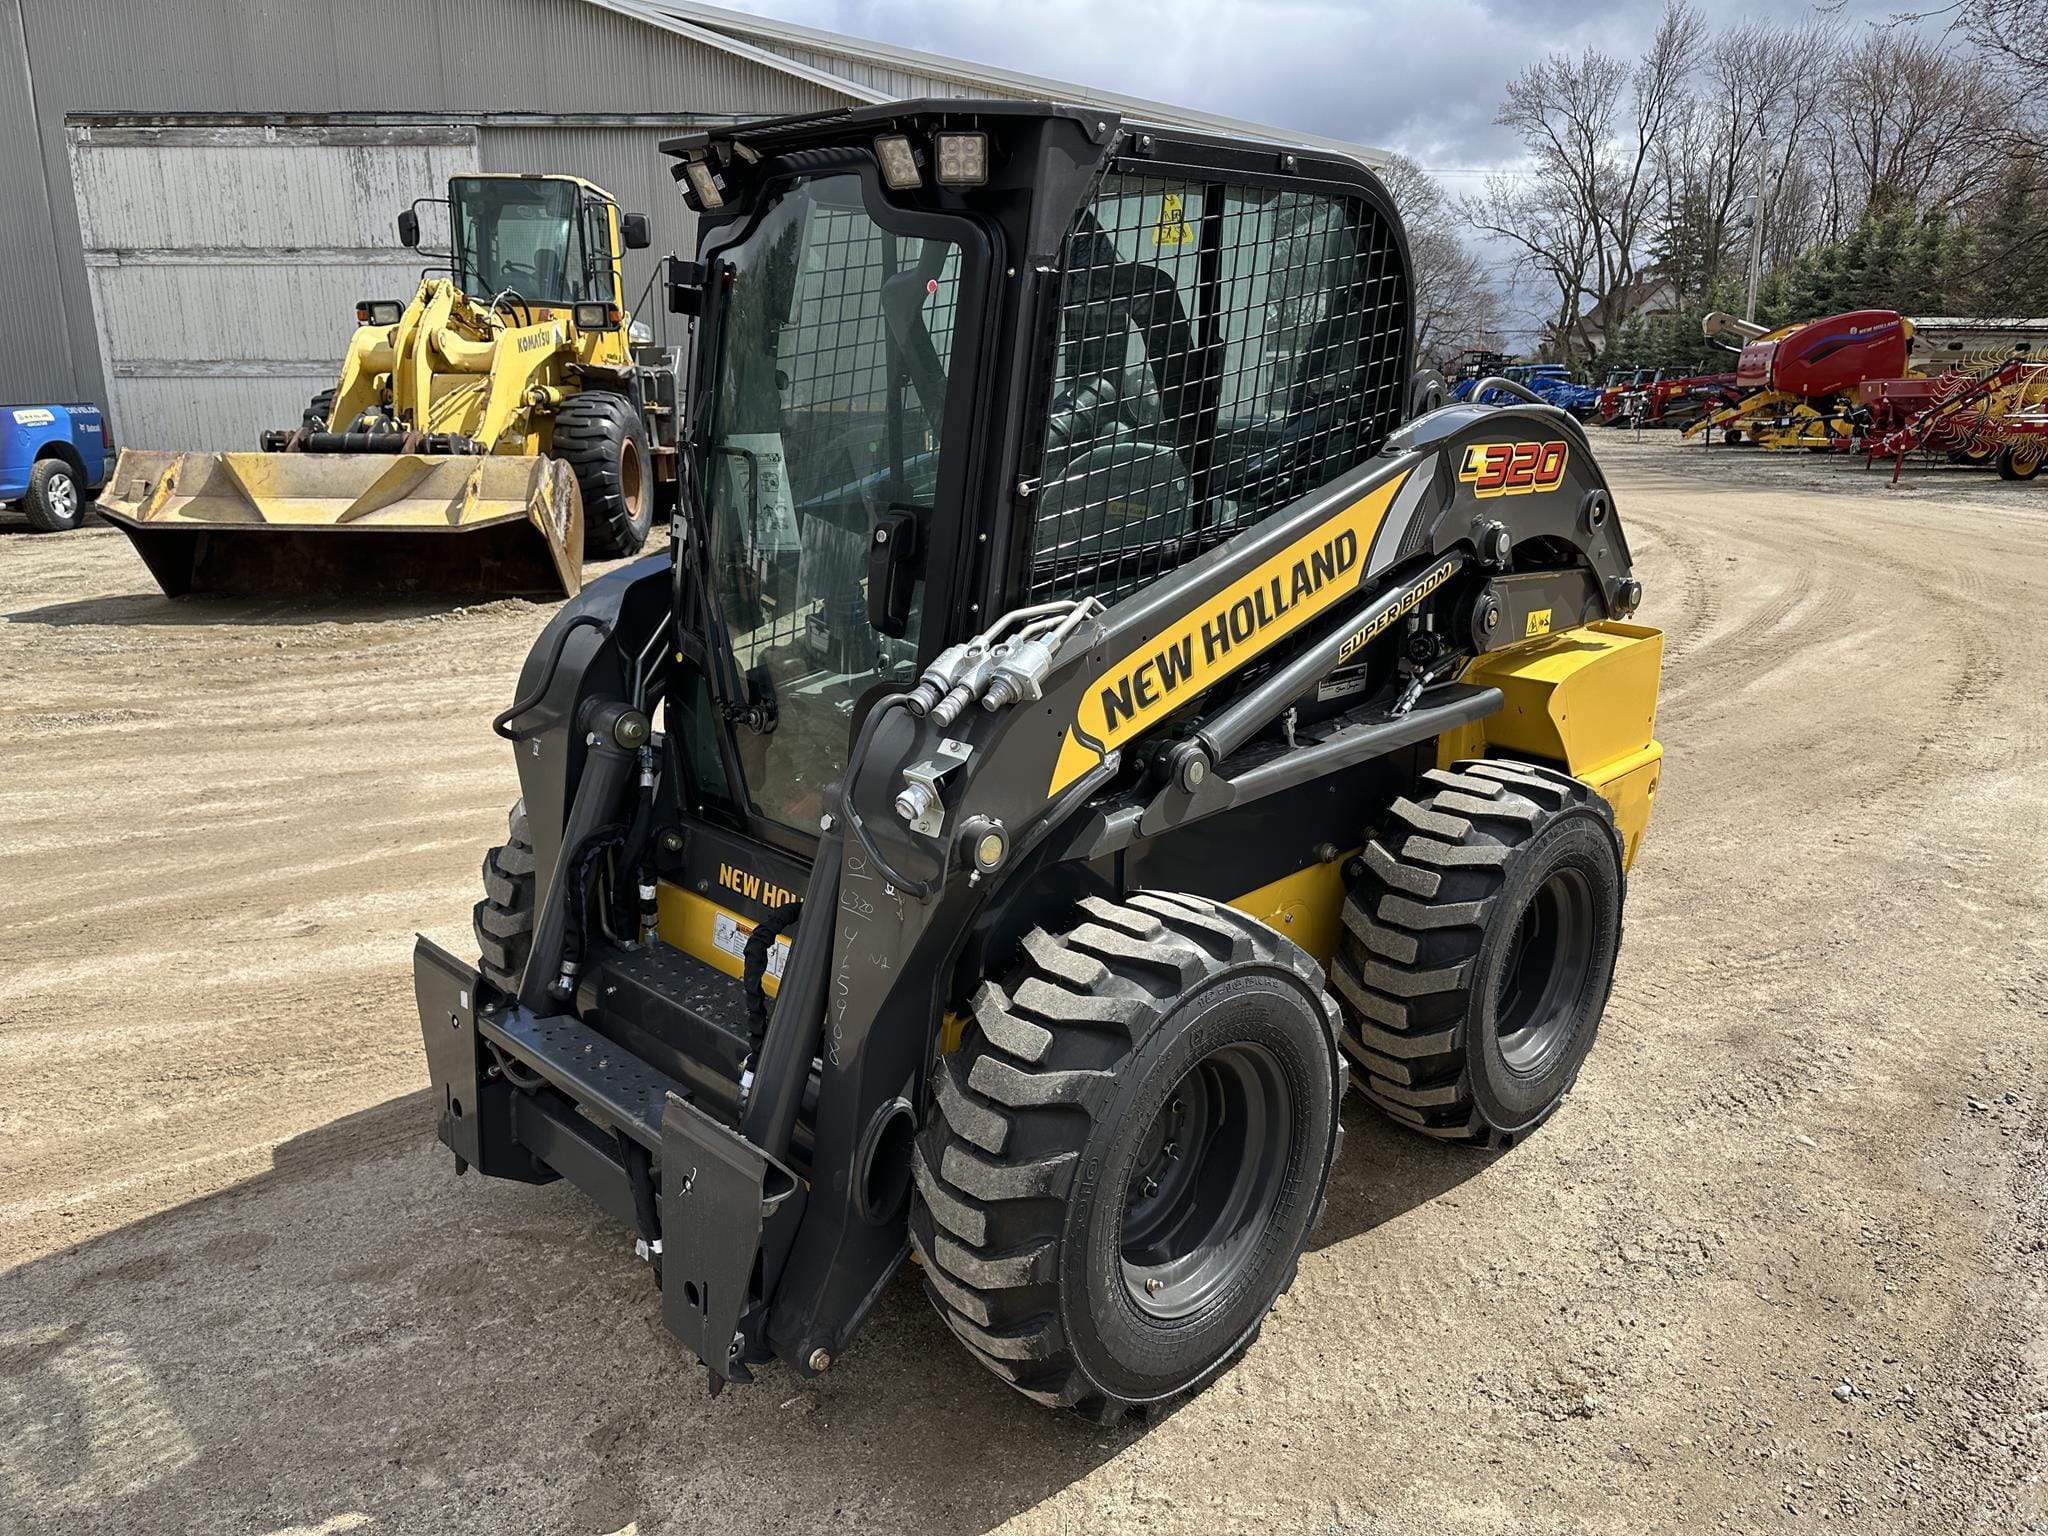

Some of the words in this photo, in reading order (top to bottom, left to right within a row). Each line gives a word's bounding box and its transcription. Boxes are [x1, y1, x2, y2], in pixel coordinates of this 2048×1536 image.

[517, 328, 550, 353] KOMATSU
[1459, 441, 1569, 499] L320
[1101, 633, 1193, 733] NEW
[1201, 528, 1358, 667] HOLLAND
[1338, 602, 1401, 664] SUPER
[1400, 562, 1452, 616] BOOM
[719, 862, 761, 901] NEW
[840, 888, 874, 914] L320
